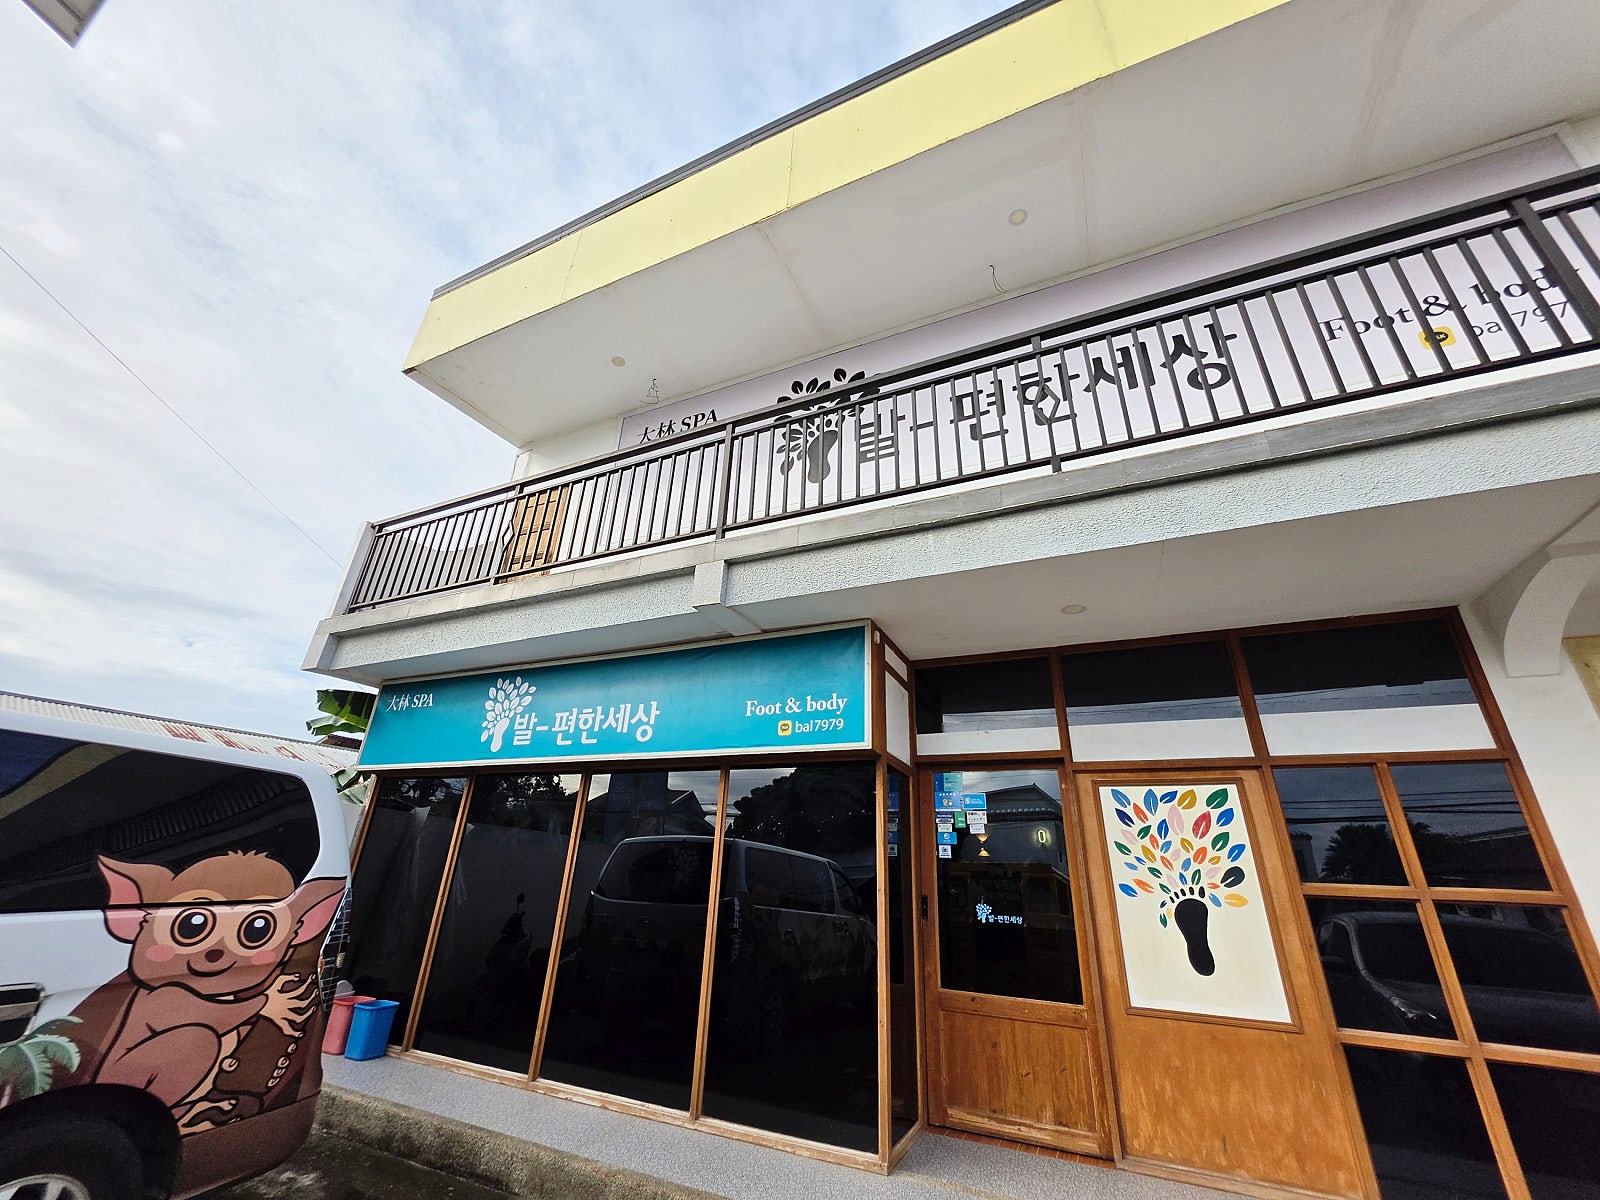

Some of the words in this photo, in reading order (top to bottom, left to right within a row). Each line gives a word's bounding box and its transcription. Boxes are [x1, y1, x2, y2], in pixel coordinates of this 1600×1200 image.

[1318, 306, 1414, 342] Foot
[1422, 294, 1467, 317] &
[1469, 266, 1581, 306] bod
[637, 420, 676, 444] 大林
[680, 409, 718, 432] SPA
[386, 694, 410, 712] 大林
[411, 693, 434, 708] SPA
[745, 700, 783, 717] Foot
[785, 697, 803, 713] &
[806, 692, 848, 715] body
[795, 718, 844, 733] bal7979
